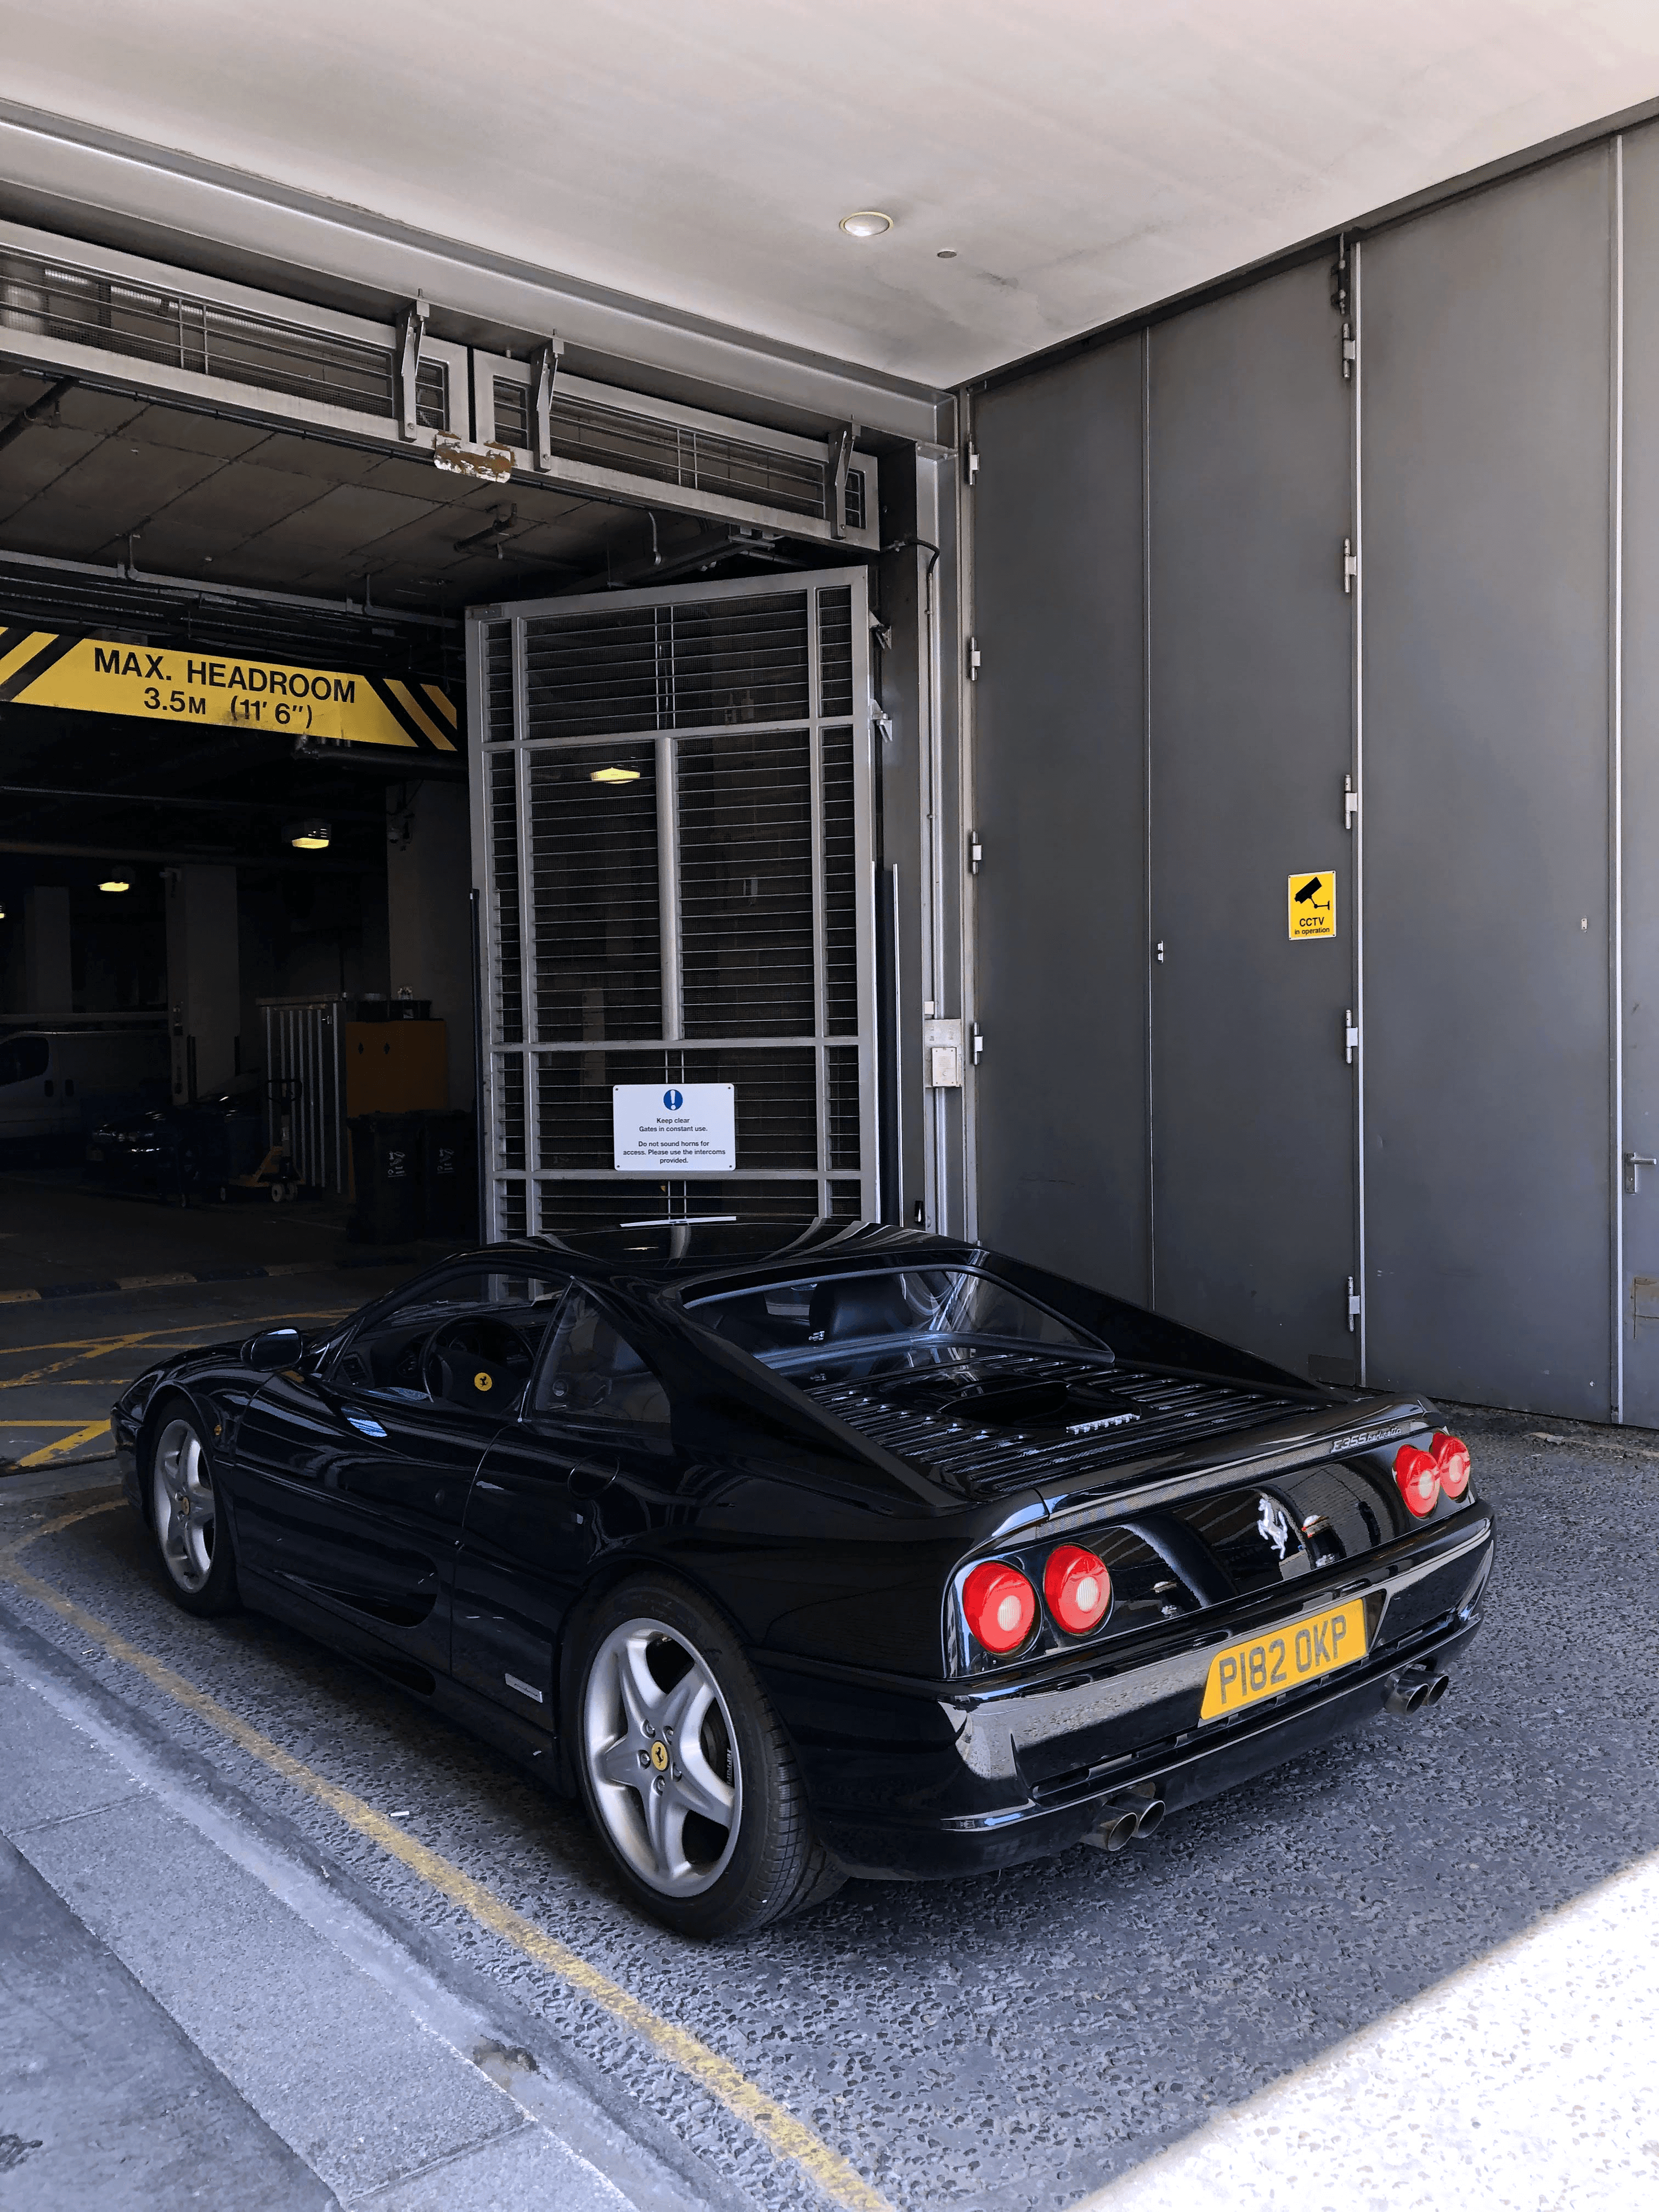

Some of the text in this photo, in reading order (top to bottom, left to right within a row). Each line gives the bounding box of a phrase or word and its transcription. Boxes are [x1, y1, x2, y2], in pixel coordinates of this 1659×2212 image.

[94, 647, 355, 703] MAX. HEADROOM
[1299, 917, 1324, 927] CCTV
[1301, 927, 1330, 935] operation
[1218, 1614, 1347, 1705] P182 OKP
